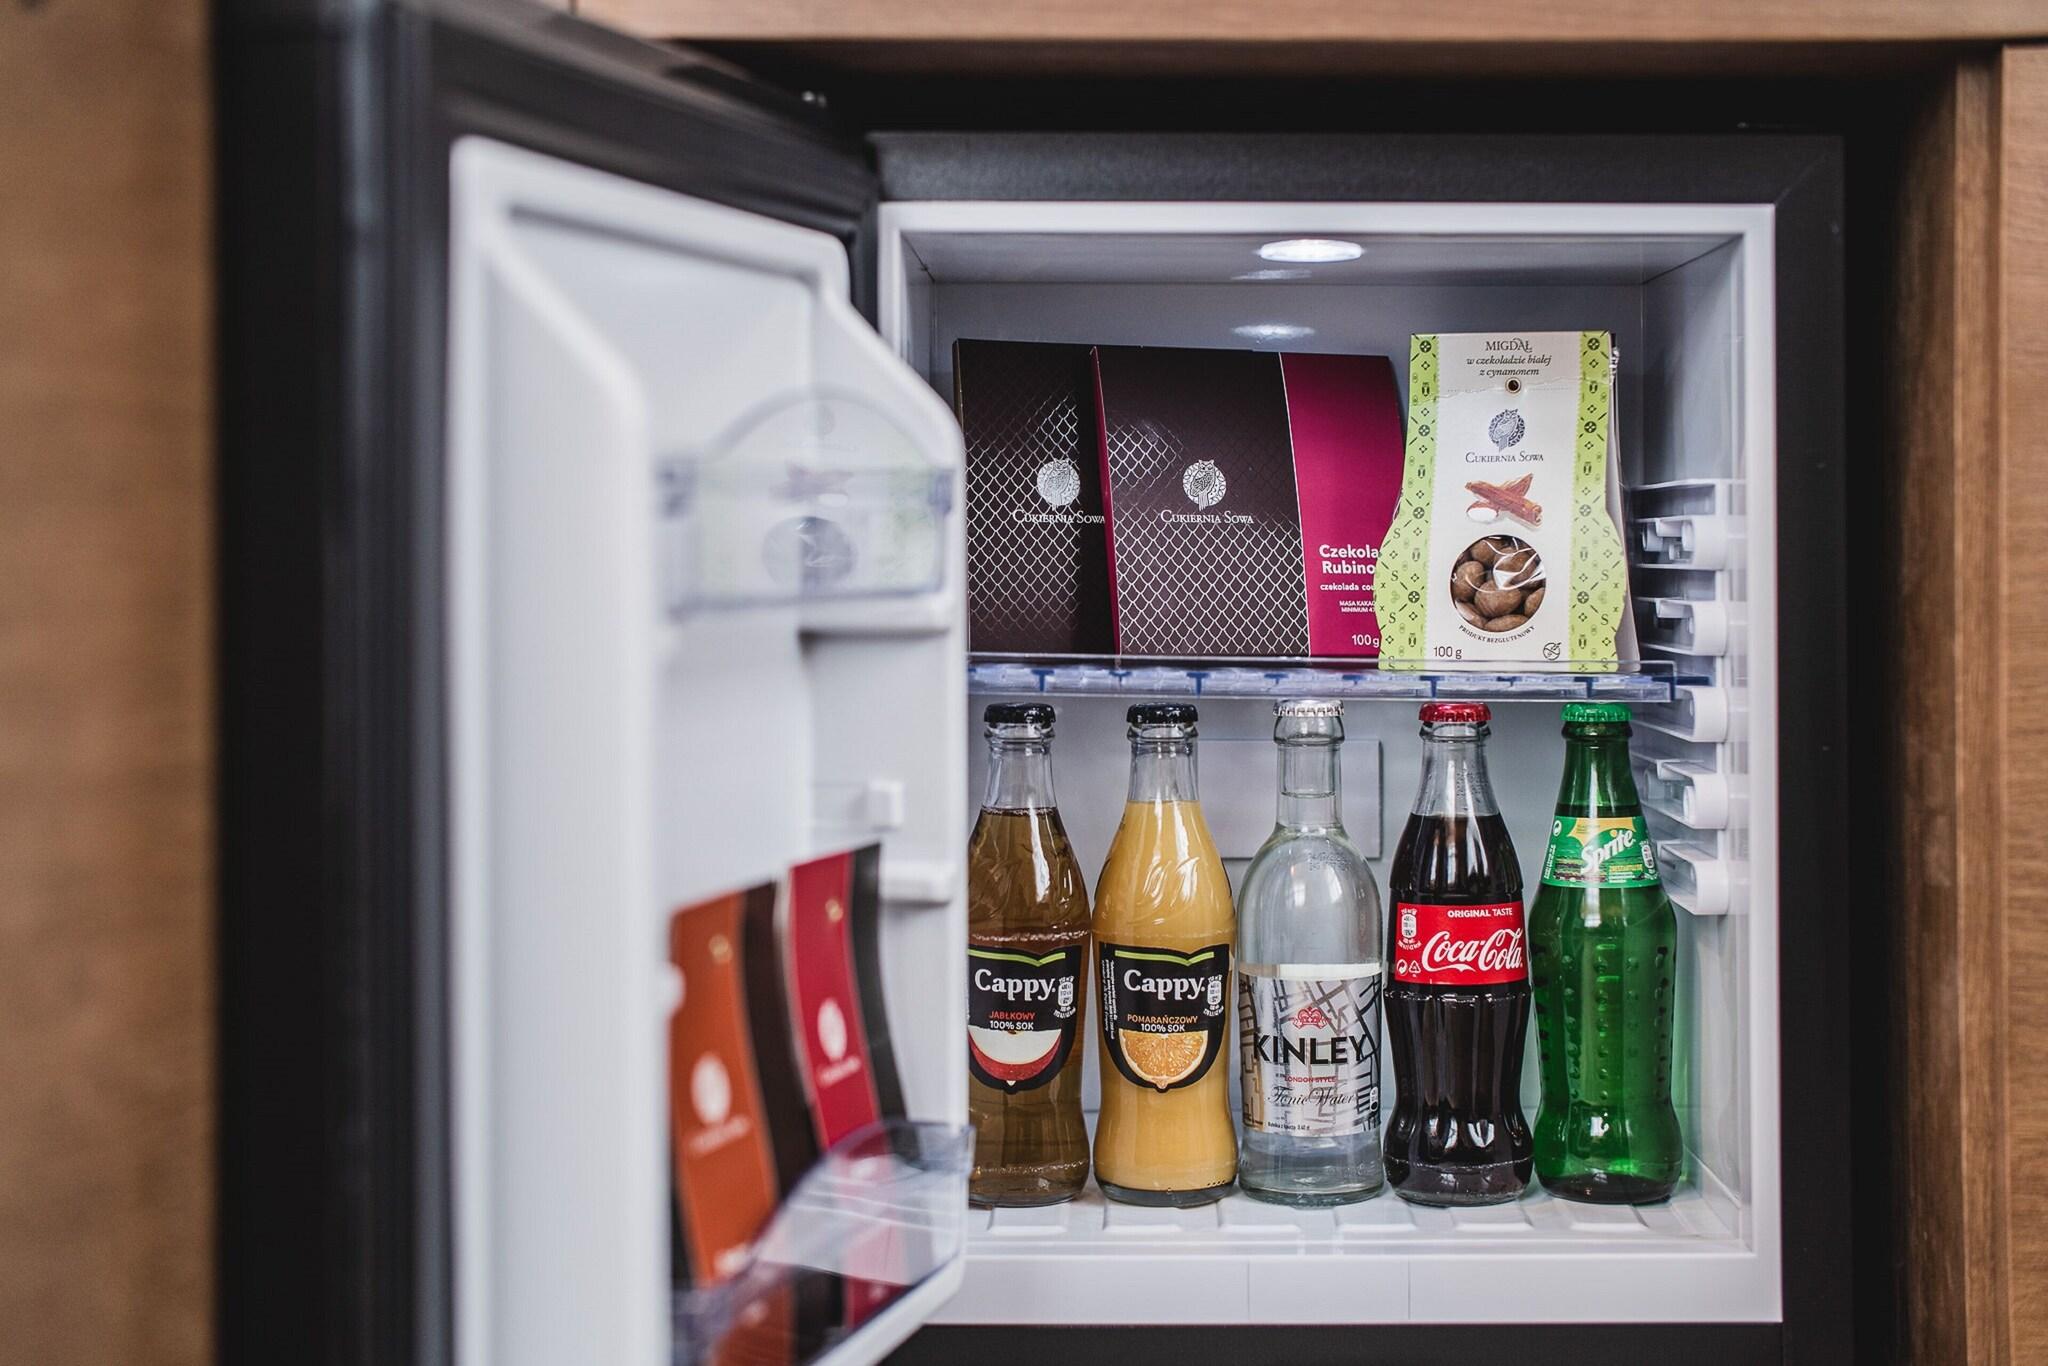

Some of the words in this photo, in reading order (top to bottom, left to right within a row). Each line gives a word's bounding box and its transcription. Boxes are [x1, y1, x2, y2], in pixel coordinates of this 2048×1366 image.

[1485, 337, 1533, 353] MIGDAŁ
[1476, 355, 1526, 365] czekoladzie
[1527, 354, 1552, 367] białej
[1486, 368, 1540, 379] cynamonem
[1319, 544, 1379, 559] Czekola
[1322, 560, 1376, 575] Rubino
[1320, 582, 1359, 591] czekolada
[1352, 634, 1371, 646] 100
[1372, 637, 1380, 648] g
[1433, 646, 1453, 658] 100
[1455, 649, 1462, 660] g
[1580, 829, 1635, 876] Sprite
[1447, 909, 1491, 918] ORIGINAL
[1492, 908, 1513, 917] TASTE
[1421, 928, 1523, 972] Coca-Cola
[974, 968, 1054, 1001] Cappy
[1123, 968, 1203, 1001] Cappy
[988, 1011, 1036, 1021] JABŁKOWY
[1126, 1013, 1199, 1025] POMARAŃCZOWY
[989, 1020, 1015, 1030] 100%
[1015, 1021, 1034, 1031] SOK
[1140, 1022, 1166, 1032] 100%
[1167, 1023, 1185, 1033] SOK
[1253, 1034, 1367, 1066] KINLEY
[1284, 1075, 1313, 1083] LONDON
[1314, 1075, 1336, 1083] STYLE
[1268, 1085, 1308, 1105] Tonic
[1308, 1086, 1355, 1106] Water
